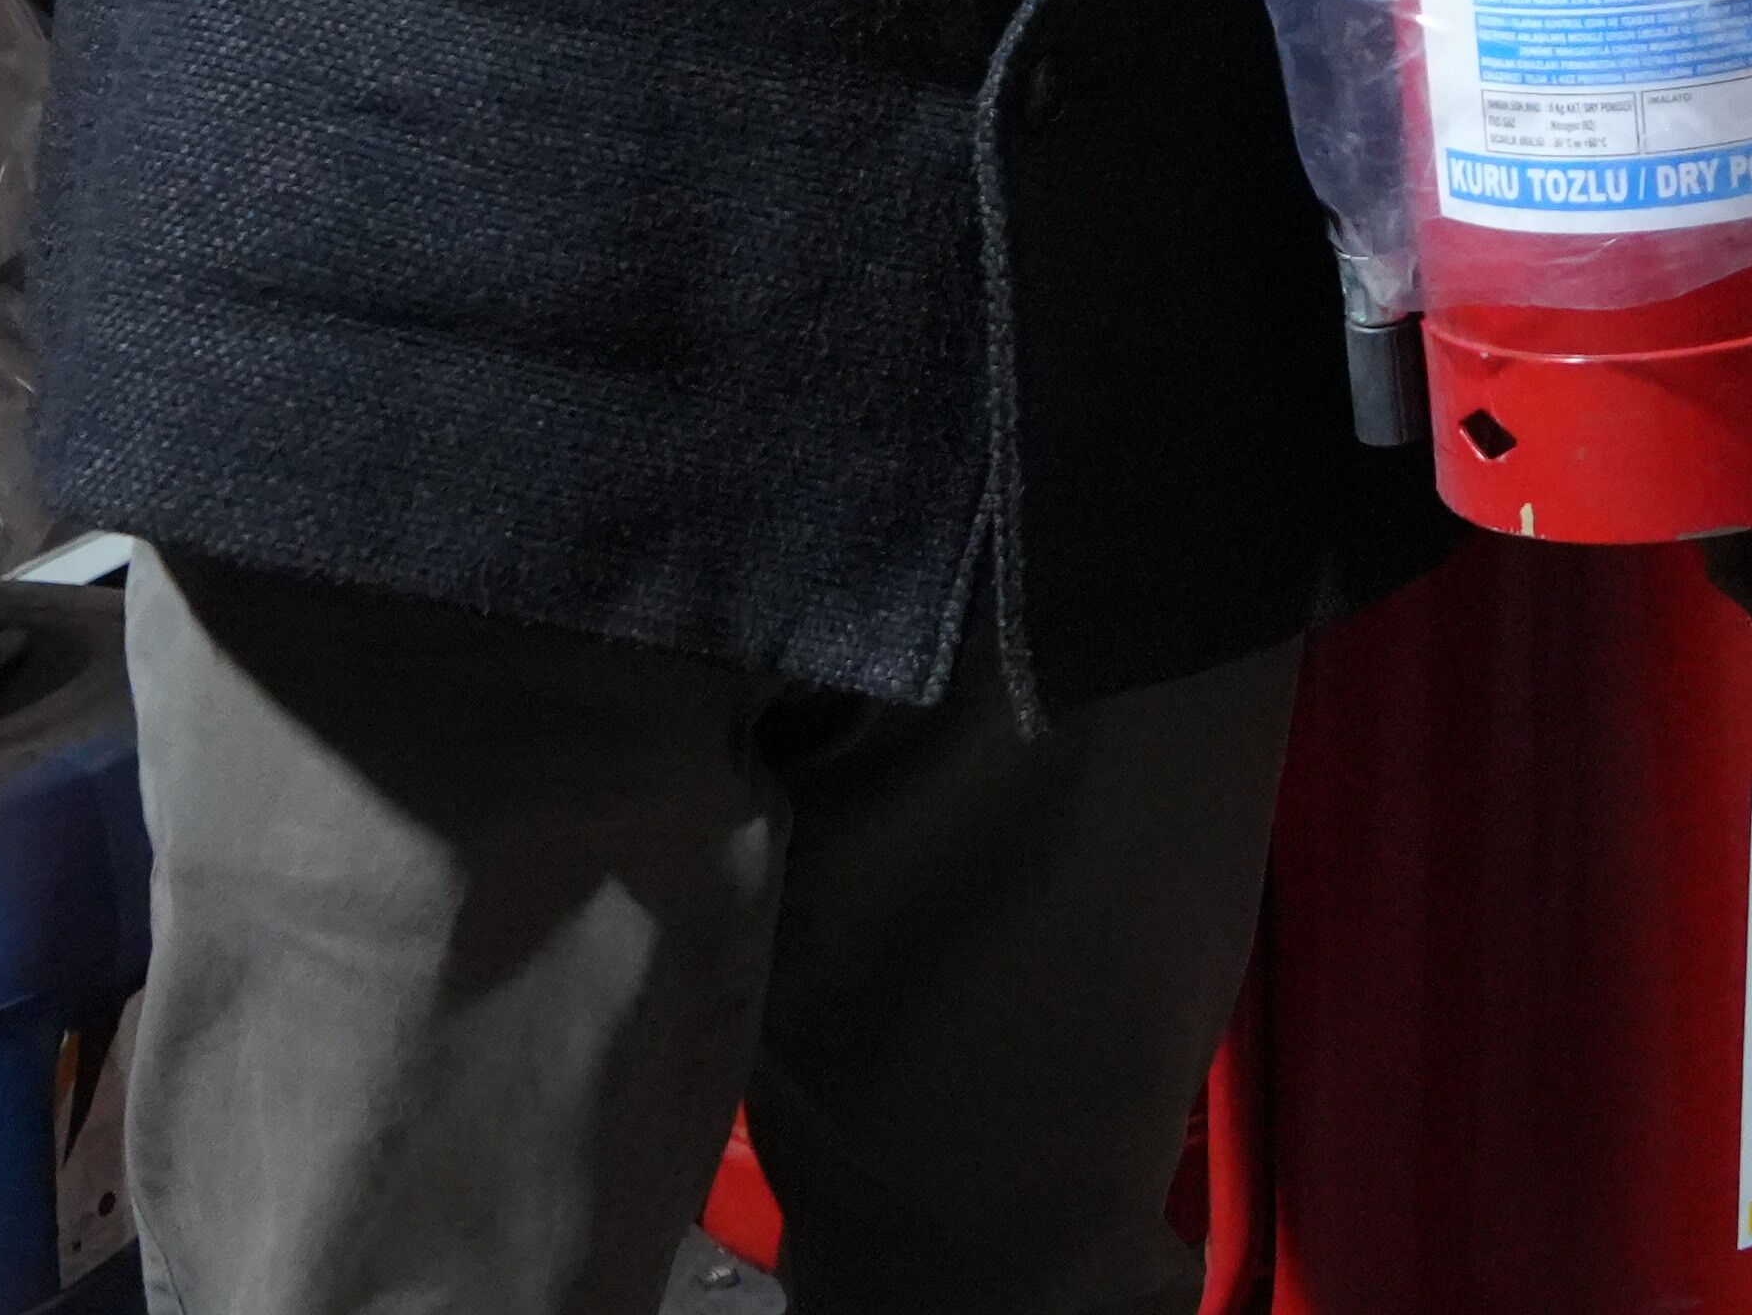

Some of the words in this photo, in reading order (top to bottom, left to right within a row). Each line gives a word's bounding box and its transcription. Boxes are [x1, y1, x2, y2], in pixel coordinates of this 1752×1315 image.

[1450, 156, 1519, 195] KURU
[1527, 167, 1629, 204] TOZLU
[1638, 169, 1646, 201] /
[1656, 159, 1719, 199] DRY
